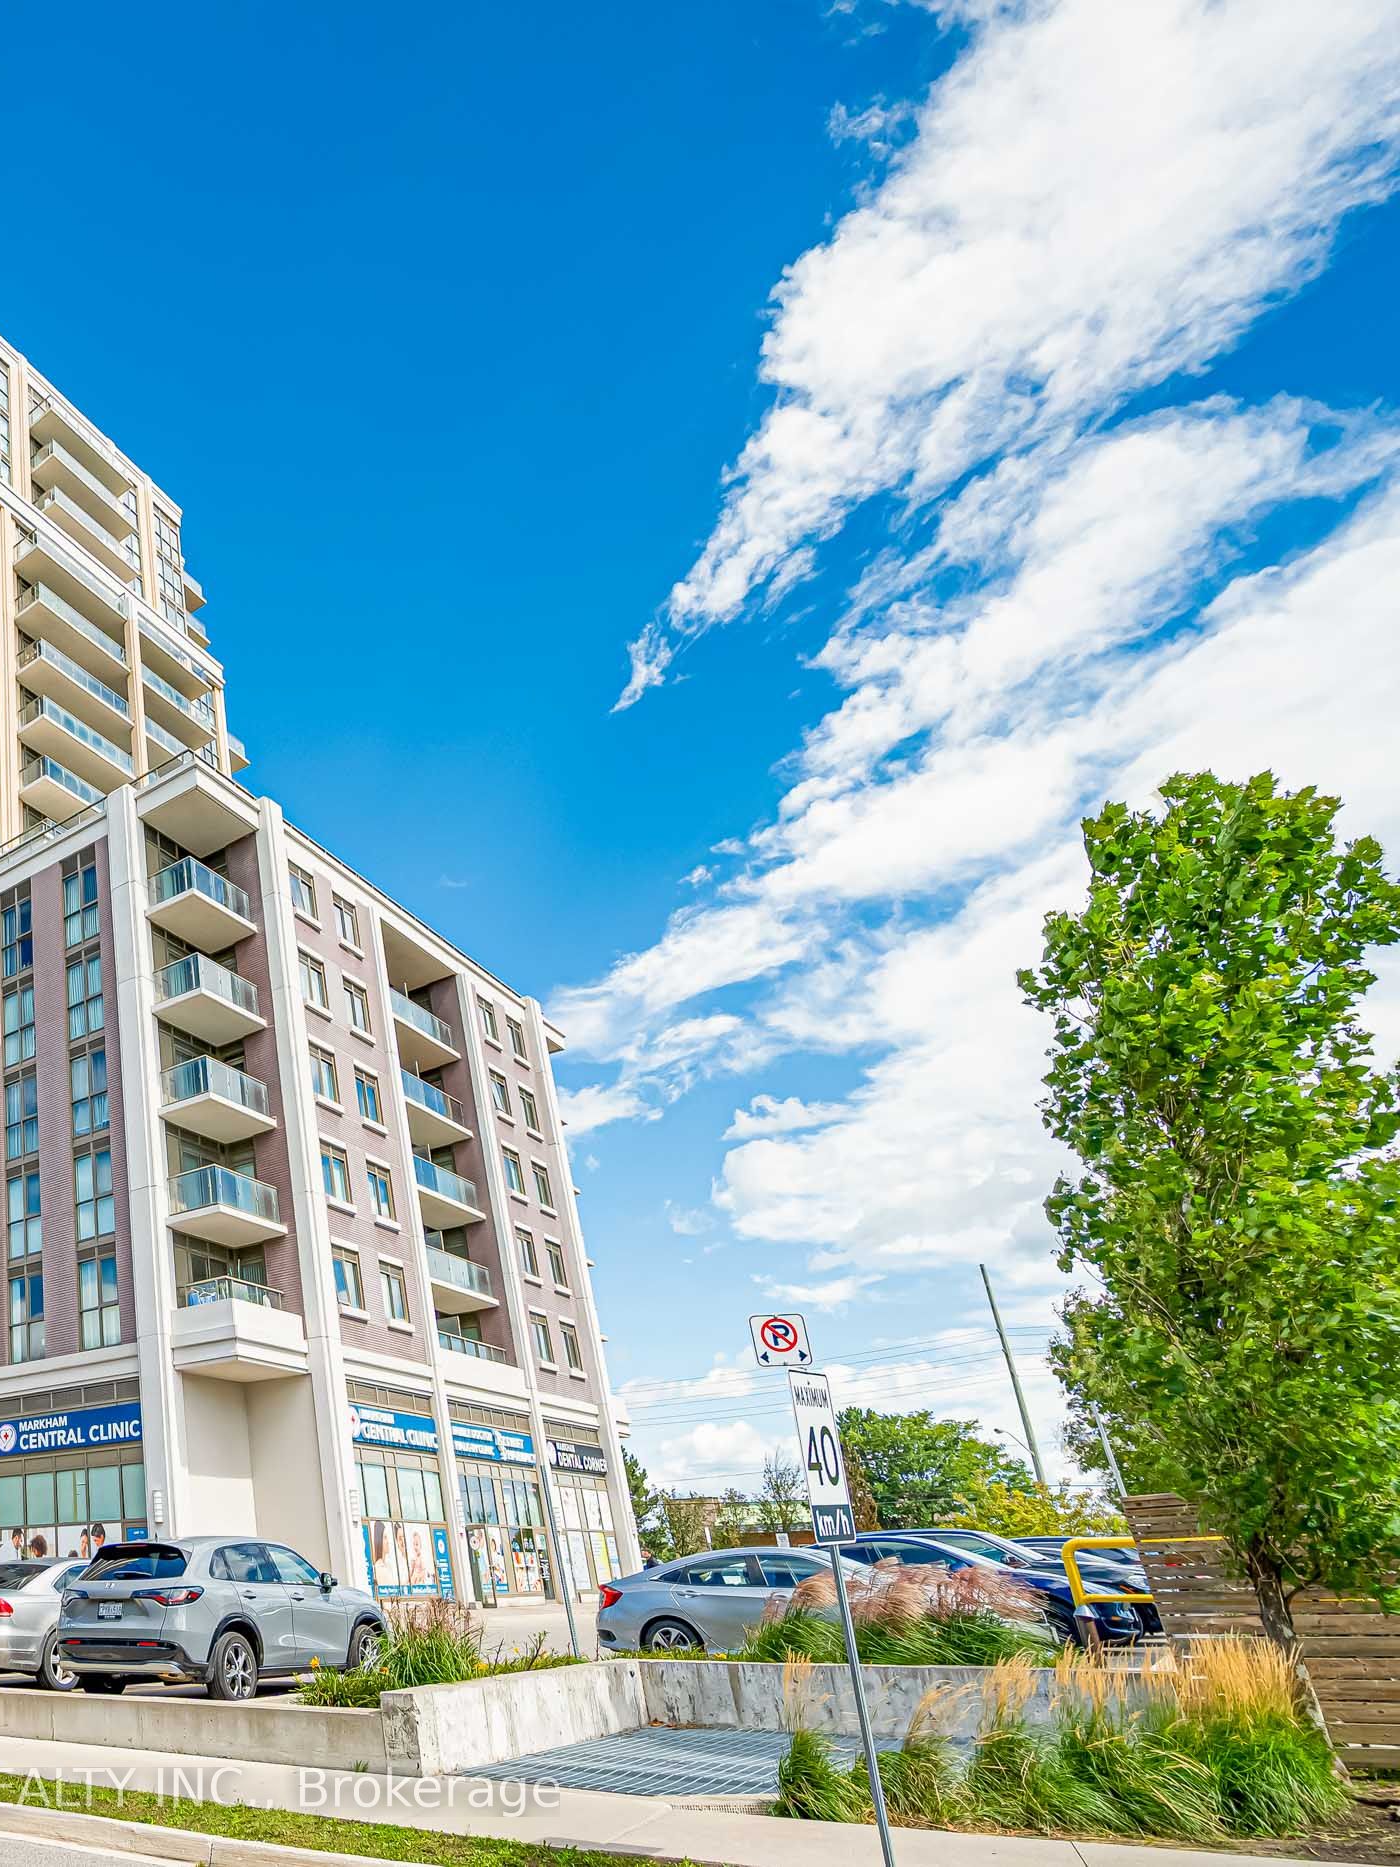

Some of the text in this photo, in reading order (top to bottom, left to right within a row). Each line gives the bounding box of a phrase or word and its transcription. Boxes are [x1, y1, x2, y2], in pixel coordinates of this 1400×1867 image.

[794, 1385, 829, 1409] MAXIMUM
[19, 1416, 68, 1432] MARKHAM
[20, 1420, 141, 1450] CENTRAL CLINIC
[557, 1452, 584, 1469] DENTAL
[808, 1425, 839, 1486] 40
[816, 1508, 851, 1537] km/h
